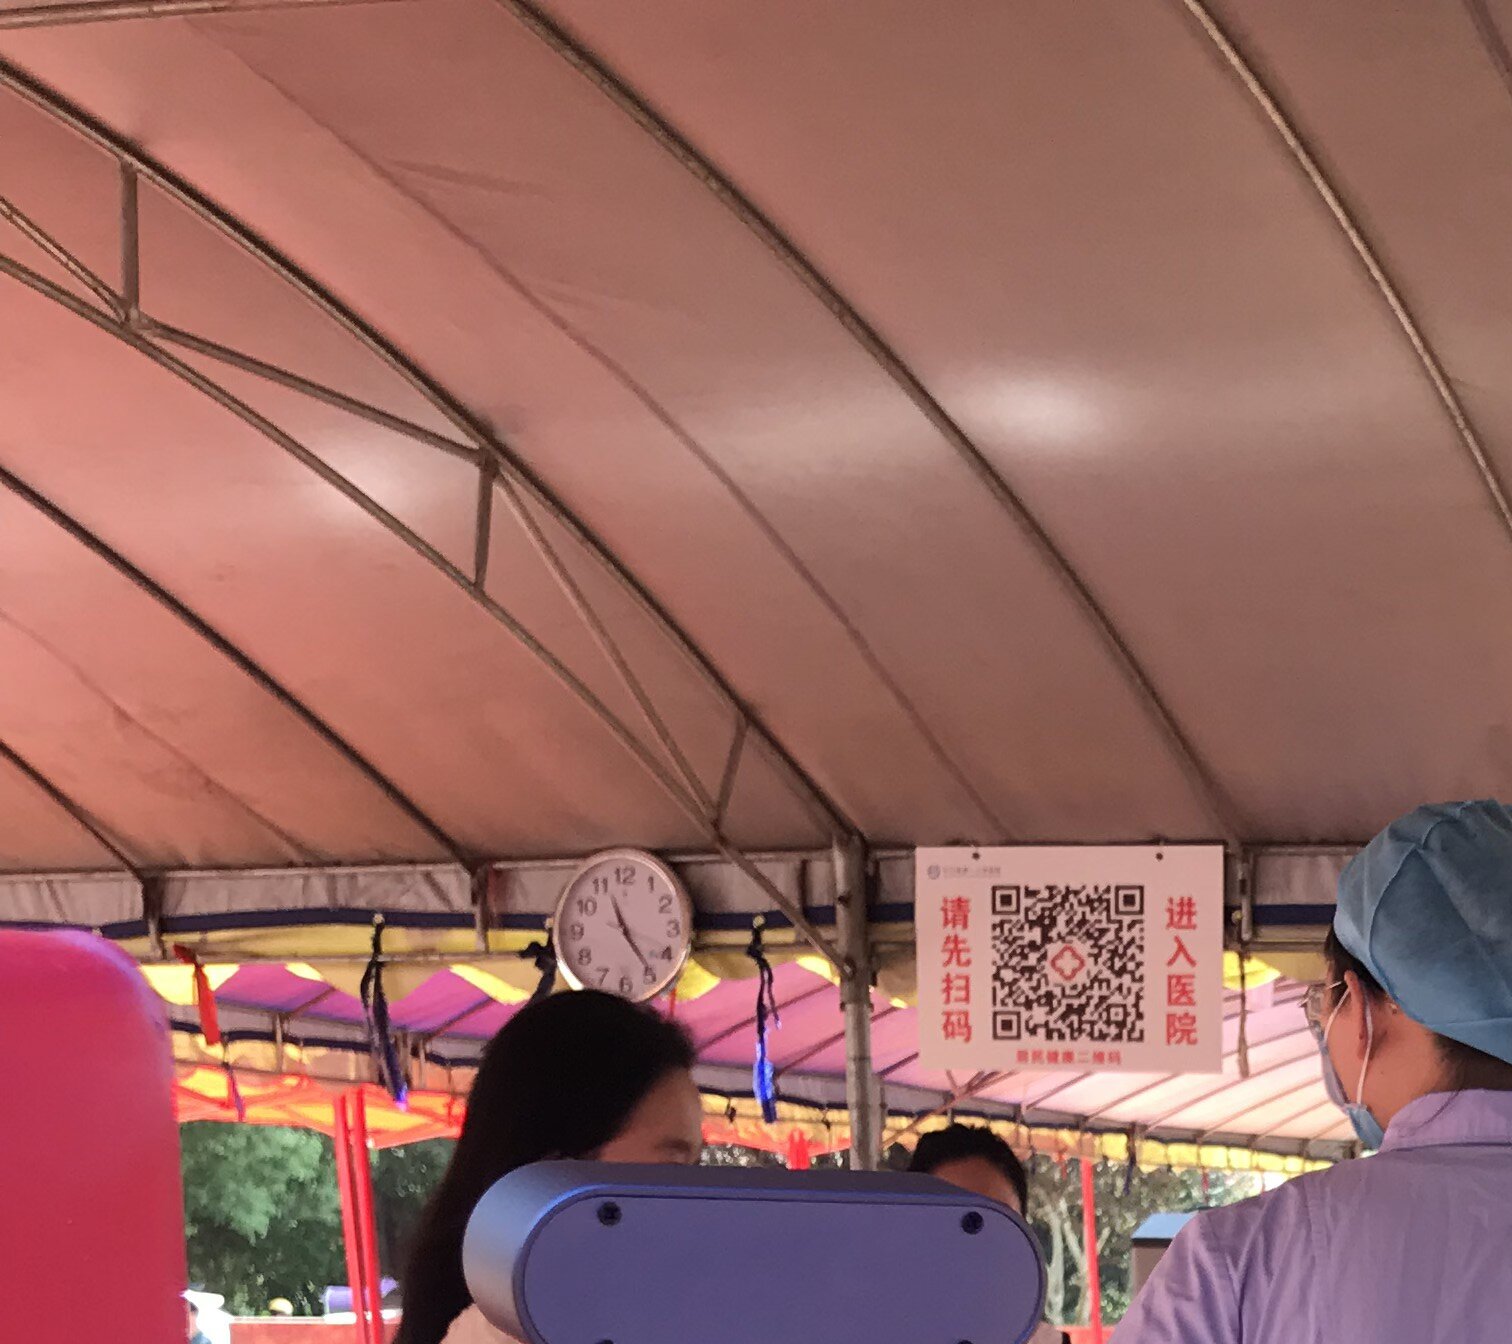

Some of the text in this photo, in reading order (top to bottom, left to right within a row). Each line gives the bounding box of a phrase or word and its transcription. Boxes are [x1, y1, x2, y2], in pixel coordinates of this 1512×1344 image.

[592, 877, 608, 894] 11
[614, 866, 636, 886] 12
[648, 876, 654, 893] 1
[577, 896, 597, 916] 10
[658, 895, 672, 913] 2
[570, 922, 584, 941] 9
[666, 919, 680, 938] 3
[578, 948, 592, 966] 8
[661, 945, 672, 961] 4
[596, 967, 610, 987] 7
[643, 966, 656, 985] 5
[941, 896, 972, 1043] 请先扫码
[1165, 896, 1198, 1046] 进入医院
[619, 975, 632, 993] 6
